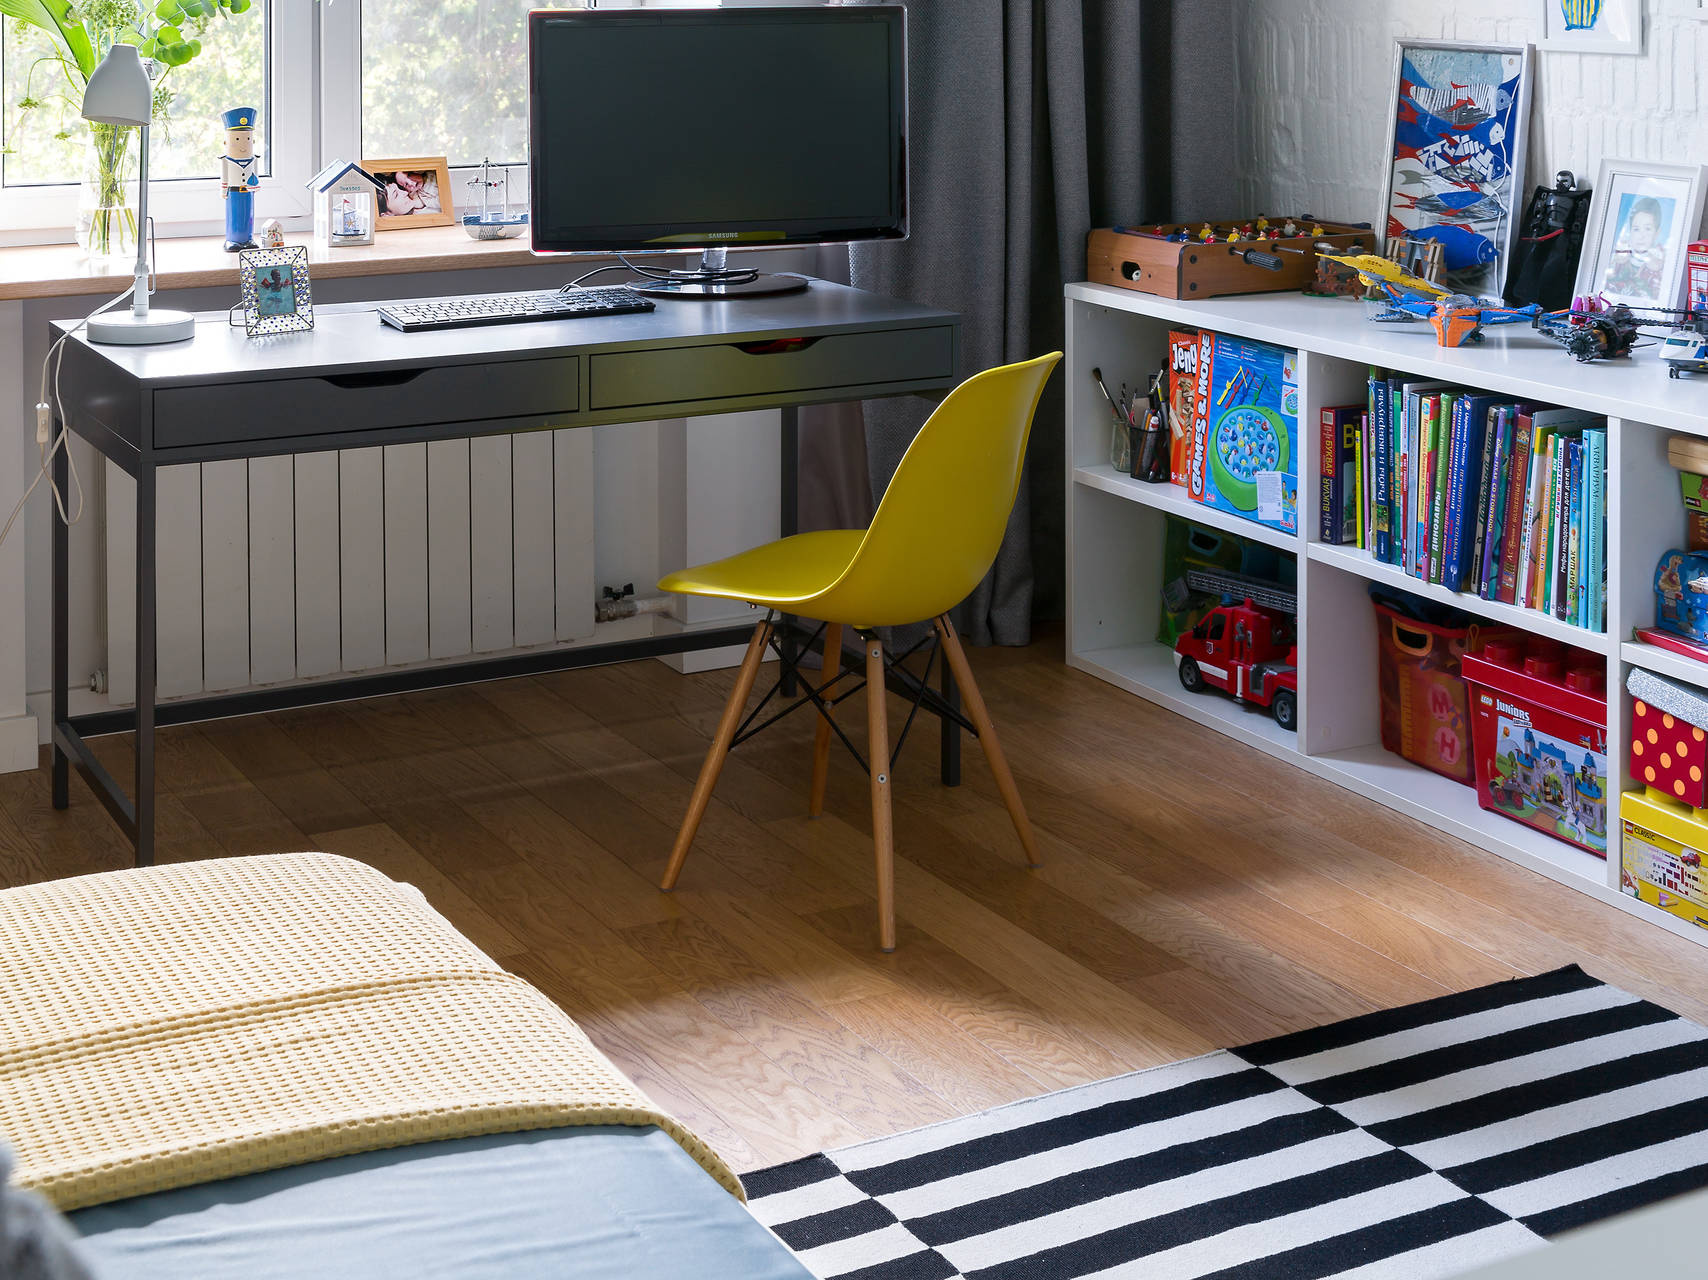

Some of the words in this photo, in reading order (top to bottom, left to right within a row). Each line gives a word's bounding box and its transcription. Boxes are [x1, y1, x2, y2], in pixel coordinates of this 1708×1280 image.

[1198, 333, 1212, 398] MORE
[1198, 400, 1208, 418] &
[1377, 388, 1386, 454] аквариумы
[1191, 418, 1208, 496] GAMES
[1325, 440, 1333, 475] БУКВАР
[1322, 477, 1331, 512] BUKVAR
[1377, 467, 1386, 502] Рыбы
[1491, 482, 1497, 493] CD
[1431, 491, 1441, 552] ДИНОЗАВРЫ
[1487, 493, 1496, 533] STORYBOOK
[1561, 524, 1569, 552] народов
[1560, 553, 1568, 574] Мифы
[1569, 550, 1577, 590] МАРШАК
[1634, 826, 1656, 841] CLASSIC
